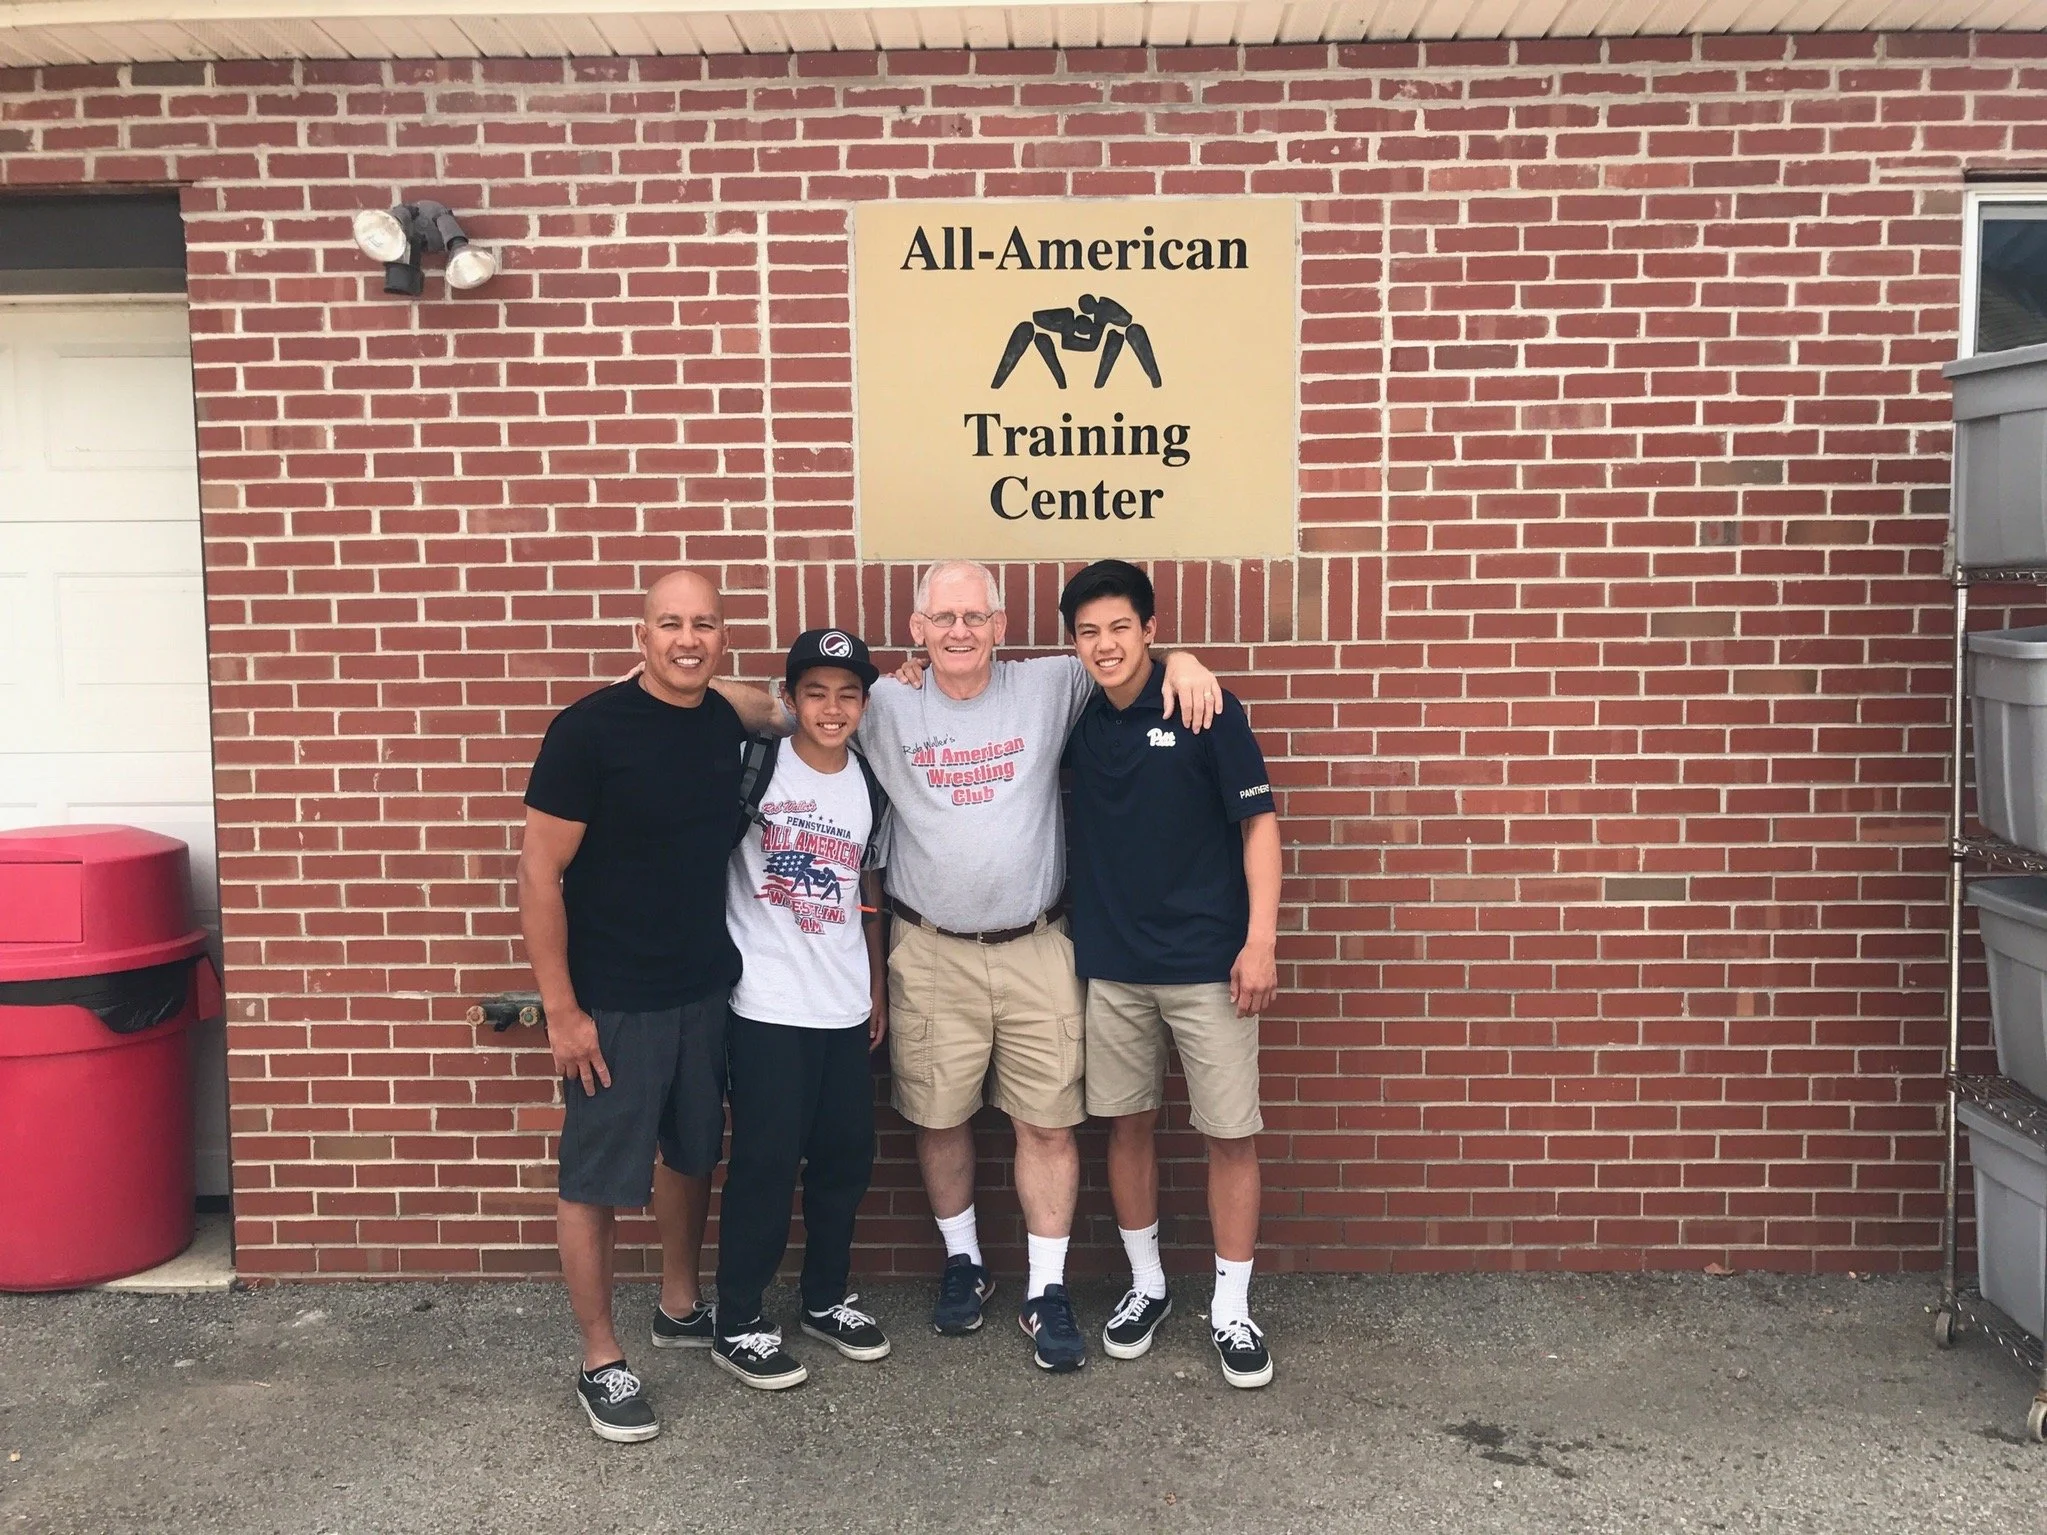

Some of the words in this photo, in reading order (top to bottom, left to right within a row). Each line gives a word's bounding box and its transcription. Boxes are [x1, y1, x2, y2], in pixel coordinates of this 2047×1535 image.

[899, 225, 1249, 270] All-American
[964, 412, 1191, 467] Training
[990, 475, 1164, 520] Center
[902, 743, 922, 755] Rob
[913, 748, 936, 766] All
[941, 737, 1025, 767] American
[927, 761, 1015, 787] Wrestling
[952, 786, 995, 805] Club
[762, 823, 792, 853] ALL
[786, 815, 851, 840] PENNSYLVANIA
